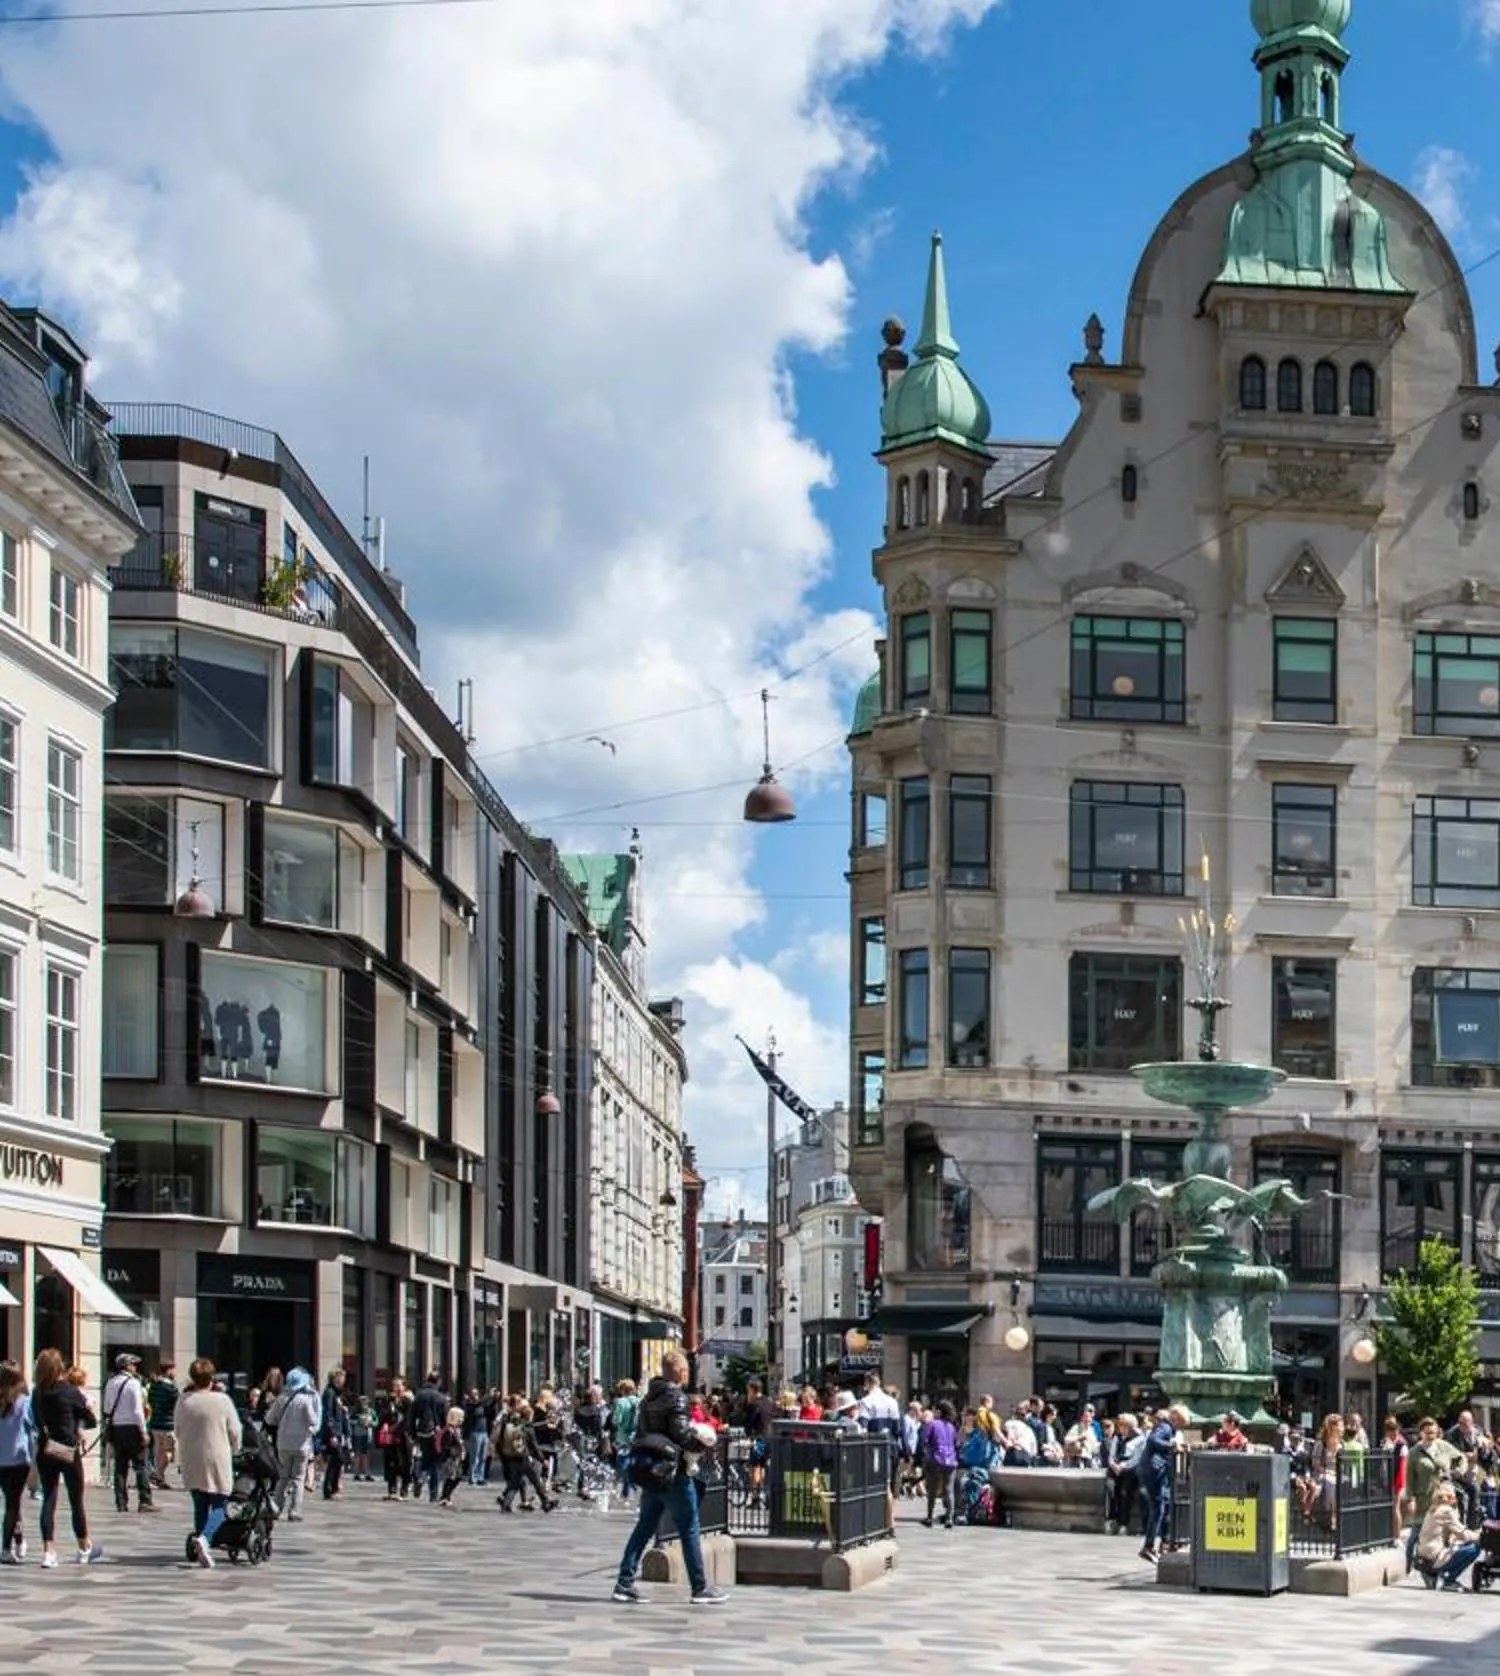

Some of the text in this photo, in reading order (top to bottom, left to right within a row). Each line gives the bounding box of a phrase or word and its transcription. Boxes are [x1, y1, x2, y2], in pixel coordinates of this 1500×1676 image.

[232, 1274, 285, 1290] PRADA
[1216, 1511, 1245, 1523] REN
[1216, 1527, 1245, 1539] KBH
